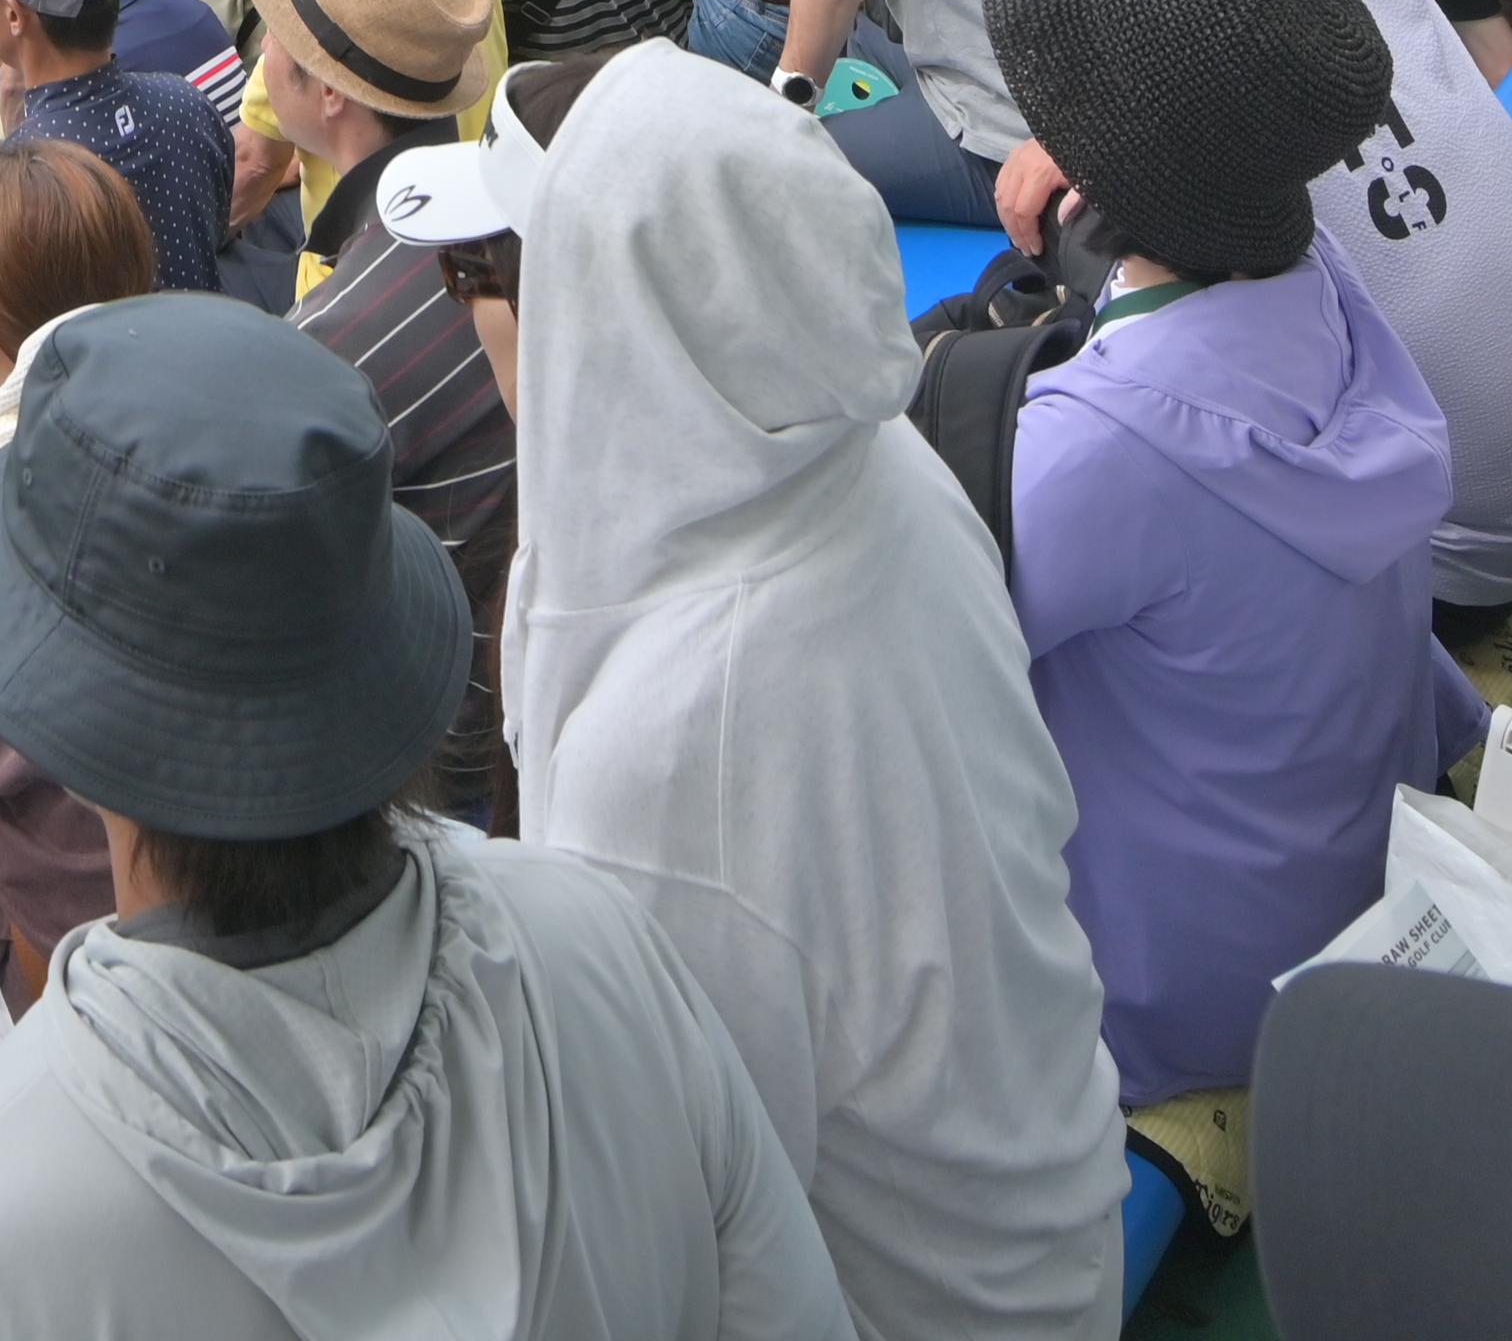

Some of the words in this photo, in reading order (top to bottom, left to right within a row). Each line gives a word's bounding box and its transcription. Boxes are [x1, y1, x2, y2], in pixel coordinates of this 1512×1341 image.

[1377, 937, 1411, 967] RAW
[1409, 903, 1443, 943] SHEET
[1407, 941, 1431, 969] GOLF
